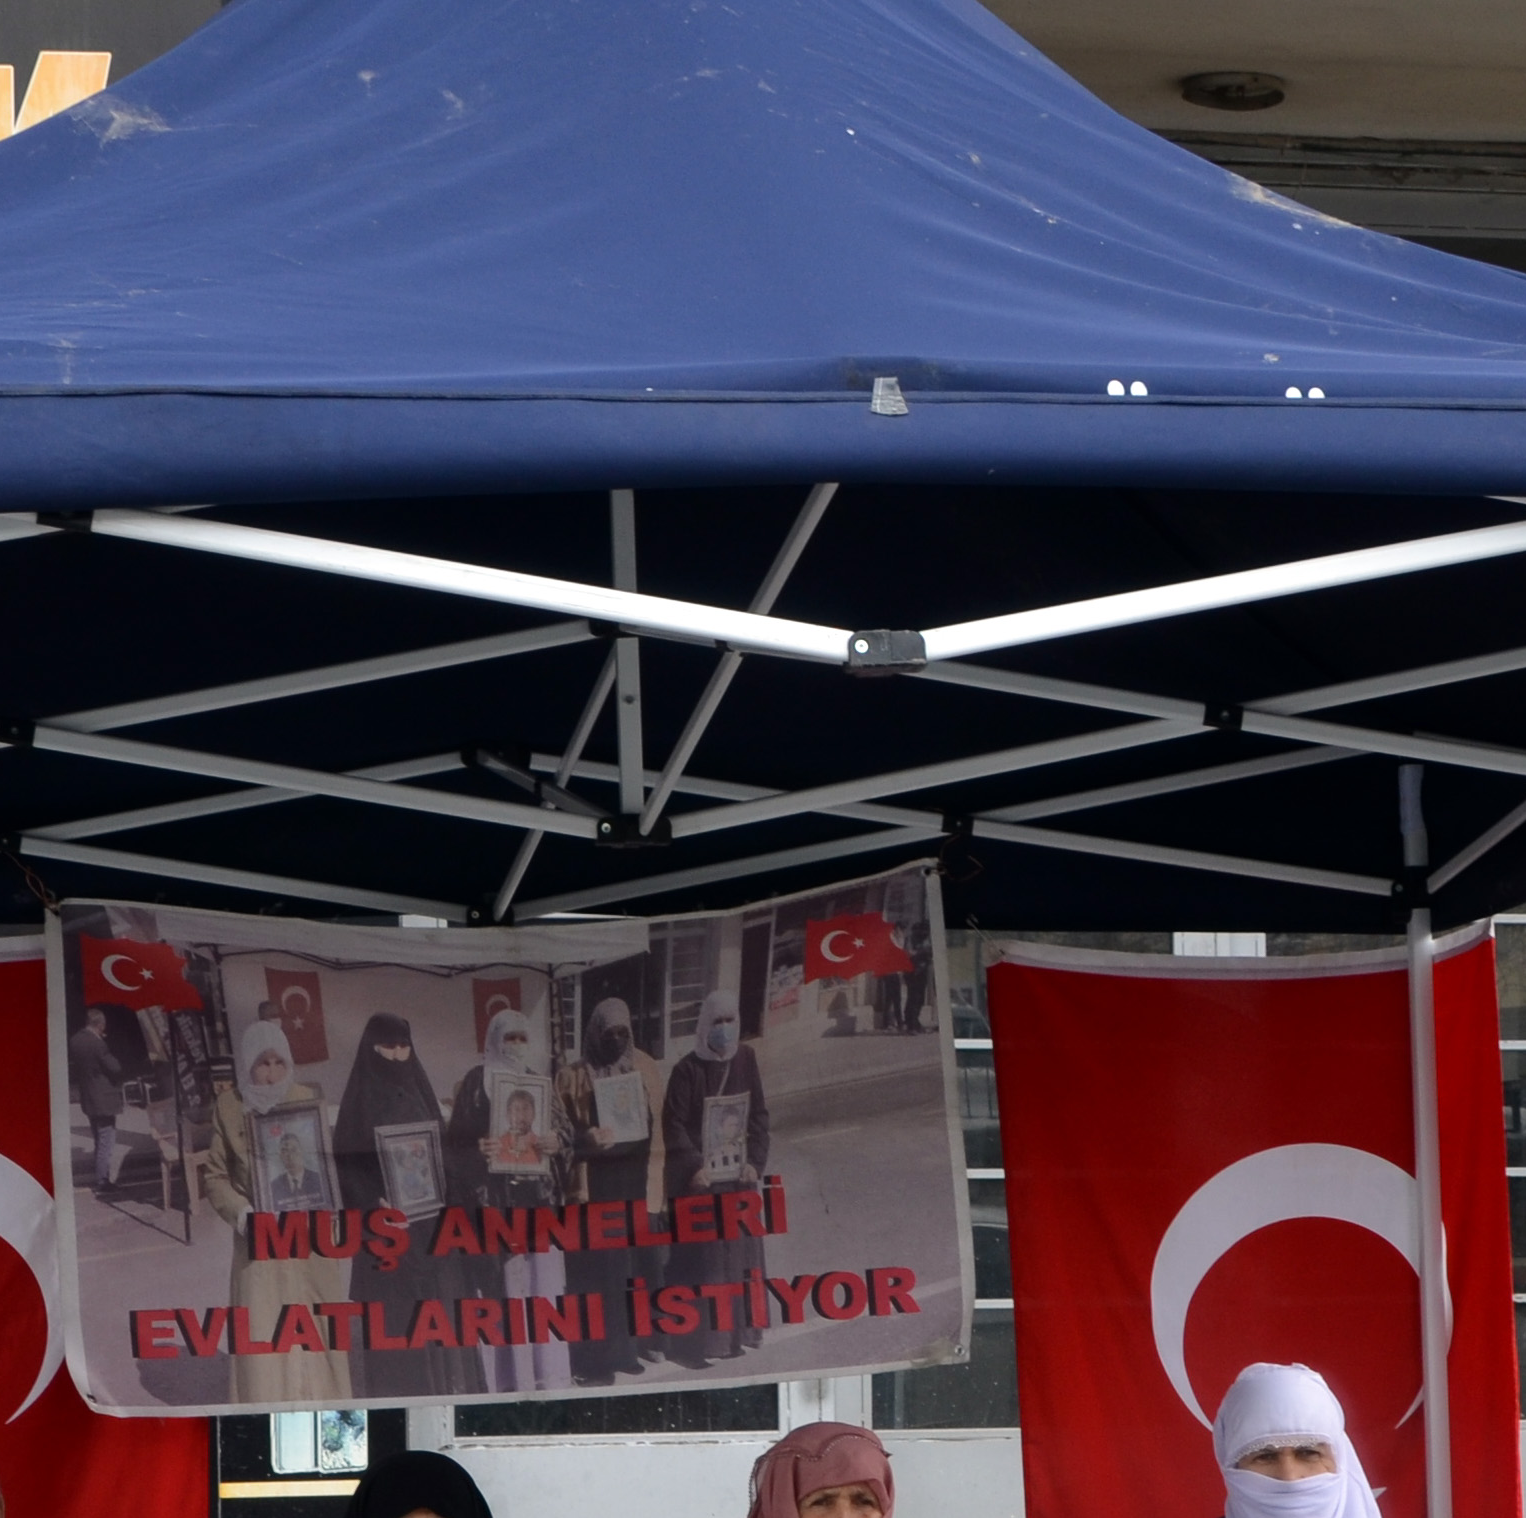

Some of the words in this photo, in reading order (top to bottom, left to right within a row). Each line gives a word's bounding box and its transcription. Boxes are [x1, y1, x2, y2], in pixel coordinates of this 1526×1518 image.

[247, 1207, 413, 1272] MUŞ
[431, 1175, 791, 1261] ANNELERİ
[130, 1293, 606, 1361] EVLATLARINI
[627, 1266, 920, 1339] İSTİYOR
